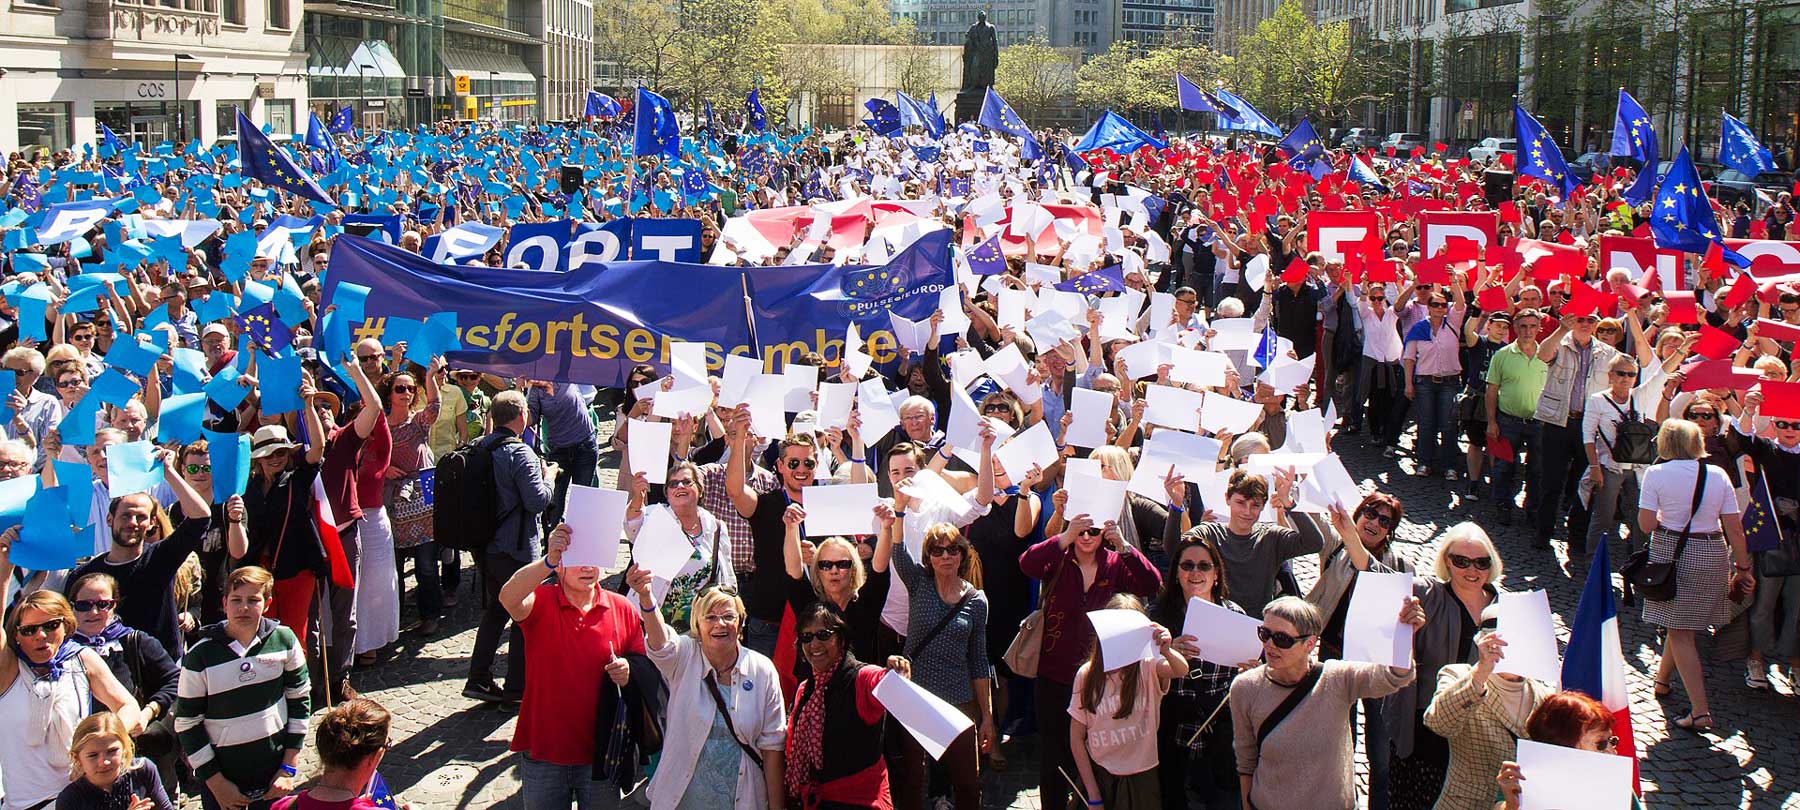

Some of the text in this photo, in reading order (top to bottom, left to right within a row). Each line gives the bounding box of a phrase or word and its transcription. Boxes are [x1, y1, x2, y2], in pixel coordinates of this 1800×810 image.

[137, 82, 165, 98] COS
[857, 296, 894, 312] PULSE
[904, 283, 946, 299] EUROP
[1090, 724, 1151, 748] SEATTL
